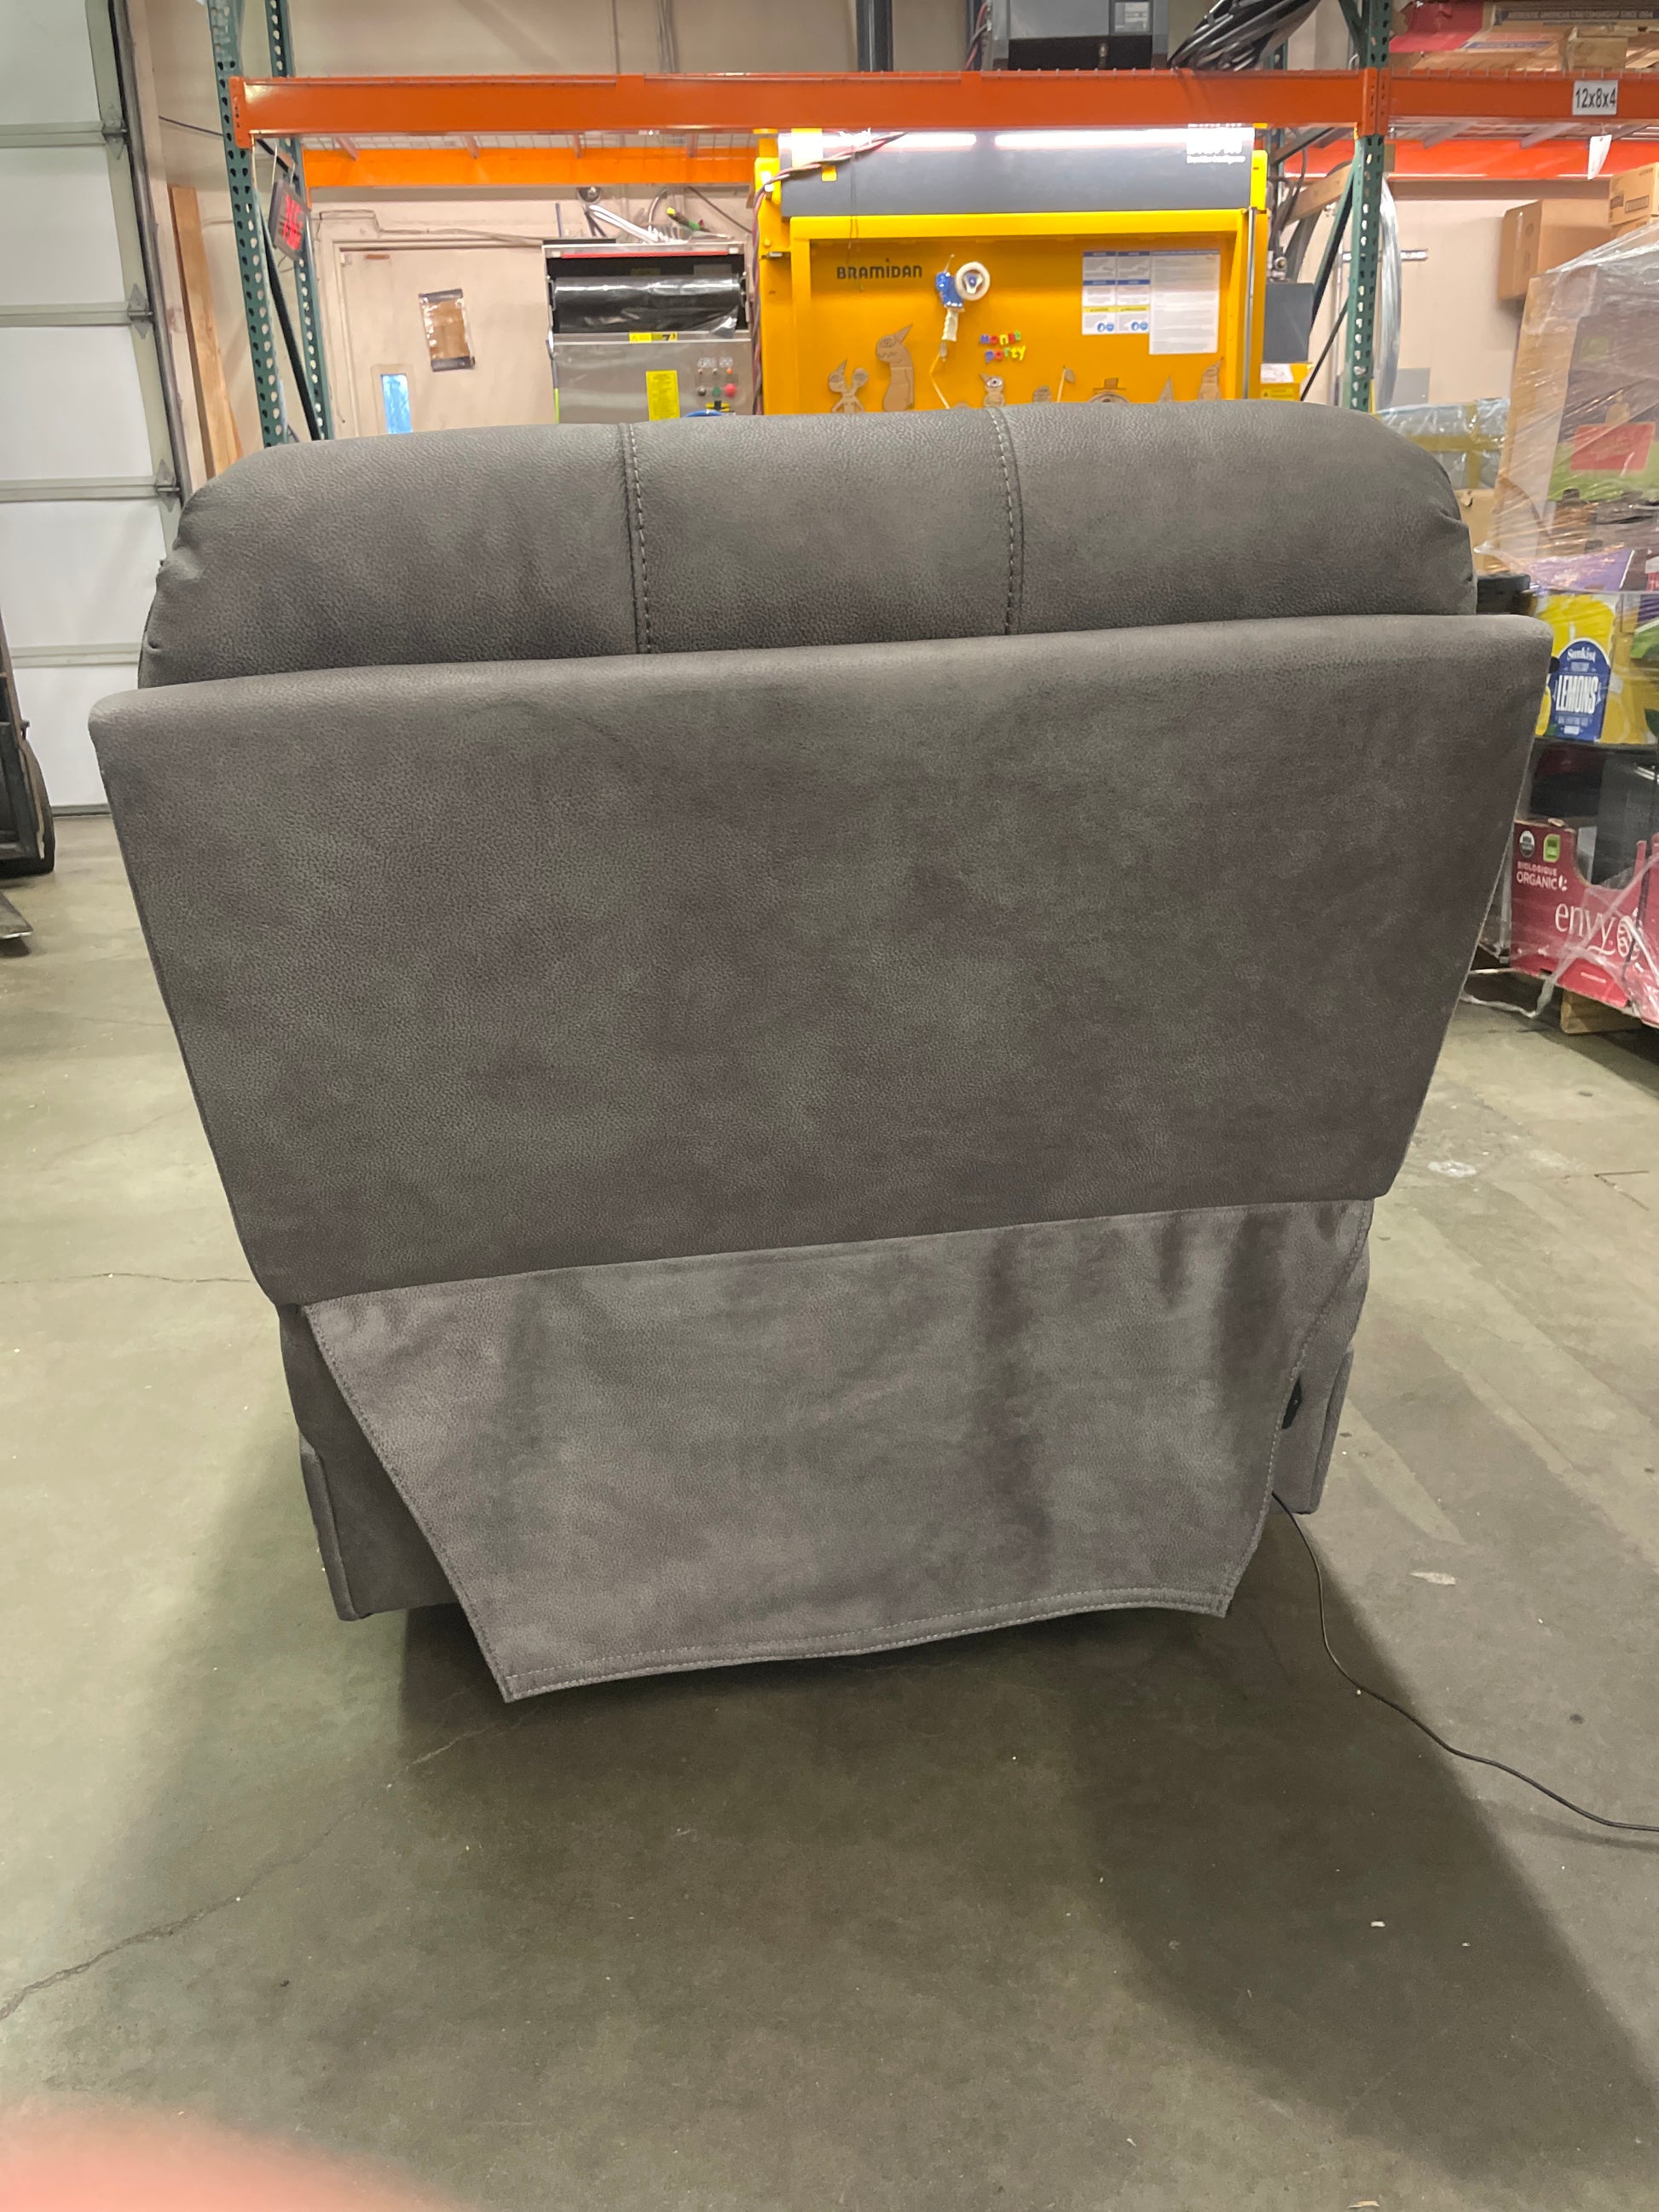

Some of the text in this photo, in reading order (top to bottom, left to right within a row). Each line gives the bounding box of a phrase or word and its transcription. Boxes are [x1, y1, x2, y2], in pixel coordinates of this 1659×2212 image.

[1575, 87, 1616, 108] 12x8x4
[1567, 647, 1596, 663] Sunkist
[1555, 674, 1599, 714] LEMONS
[1517, 861, 1558, 876] BIOLOGIQUE
[1516, 871, 1558, 890] ORGANIC
[1555, 903, 1617, 956] envy
